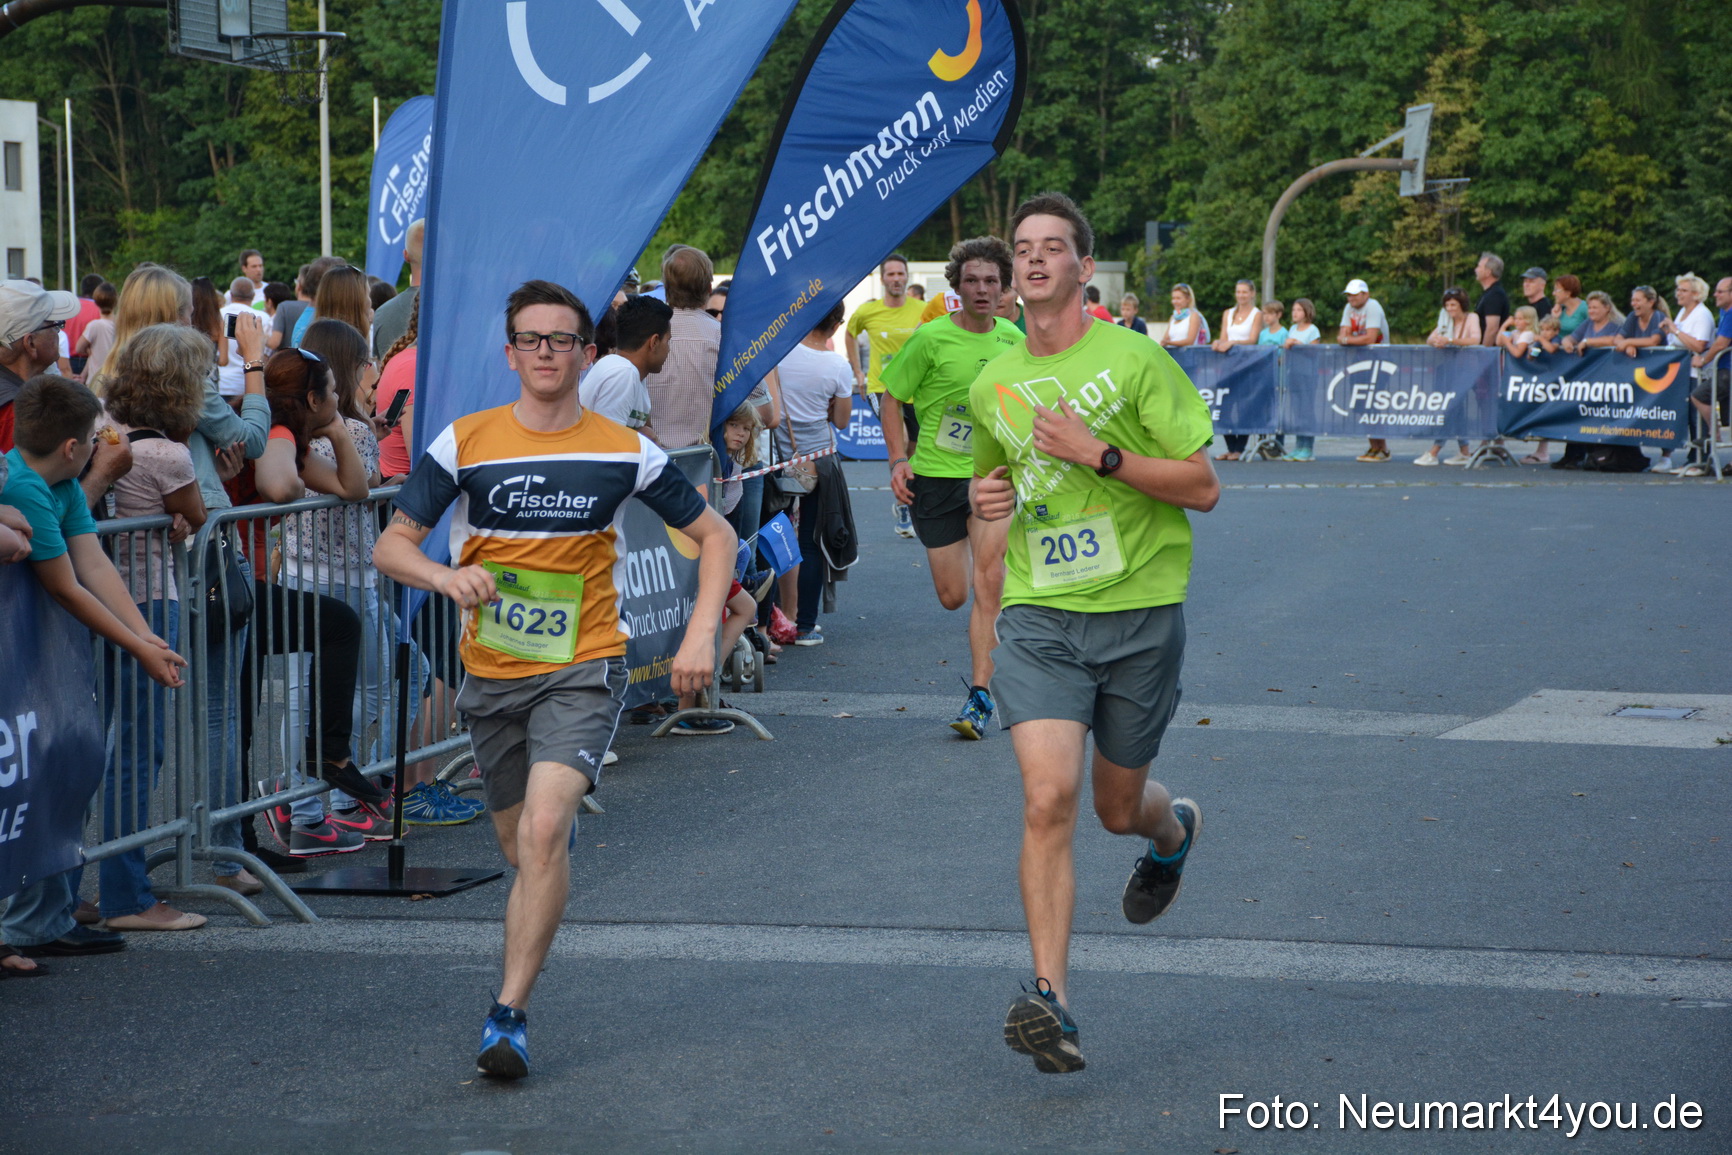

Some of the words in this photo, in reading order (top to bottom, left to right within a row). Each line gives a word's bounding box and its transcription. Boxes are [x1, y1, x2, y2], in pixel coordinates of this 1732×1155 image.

[876, 150, 922, 200] Druck
[953, 69, 1008, 134] Medien
[391, 122, 432, 226] Fische
[757, 91, 944, 276] Frischmann
[1349, 384, 1456, 411] Fischer
[1507, 375, 1634, 404] Frischmann
[1359, 413, 1445, 426] AUTOMOBILE
[1578, 404, 1610, 418] Druck
[1612, 406, 1633, 419] und
[1633, 406, 1677, 421] Medien
[507, 490, 599, 509] Fischer
[515, 510, 591, 519] AUTOMOBILE
[1041, 528, 1101, 566] 203
[489, 597, 568, 638] 1623
[626, 605, 658, 640] Druck
[658, 598, 680, 632] und
